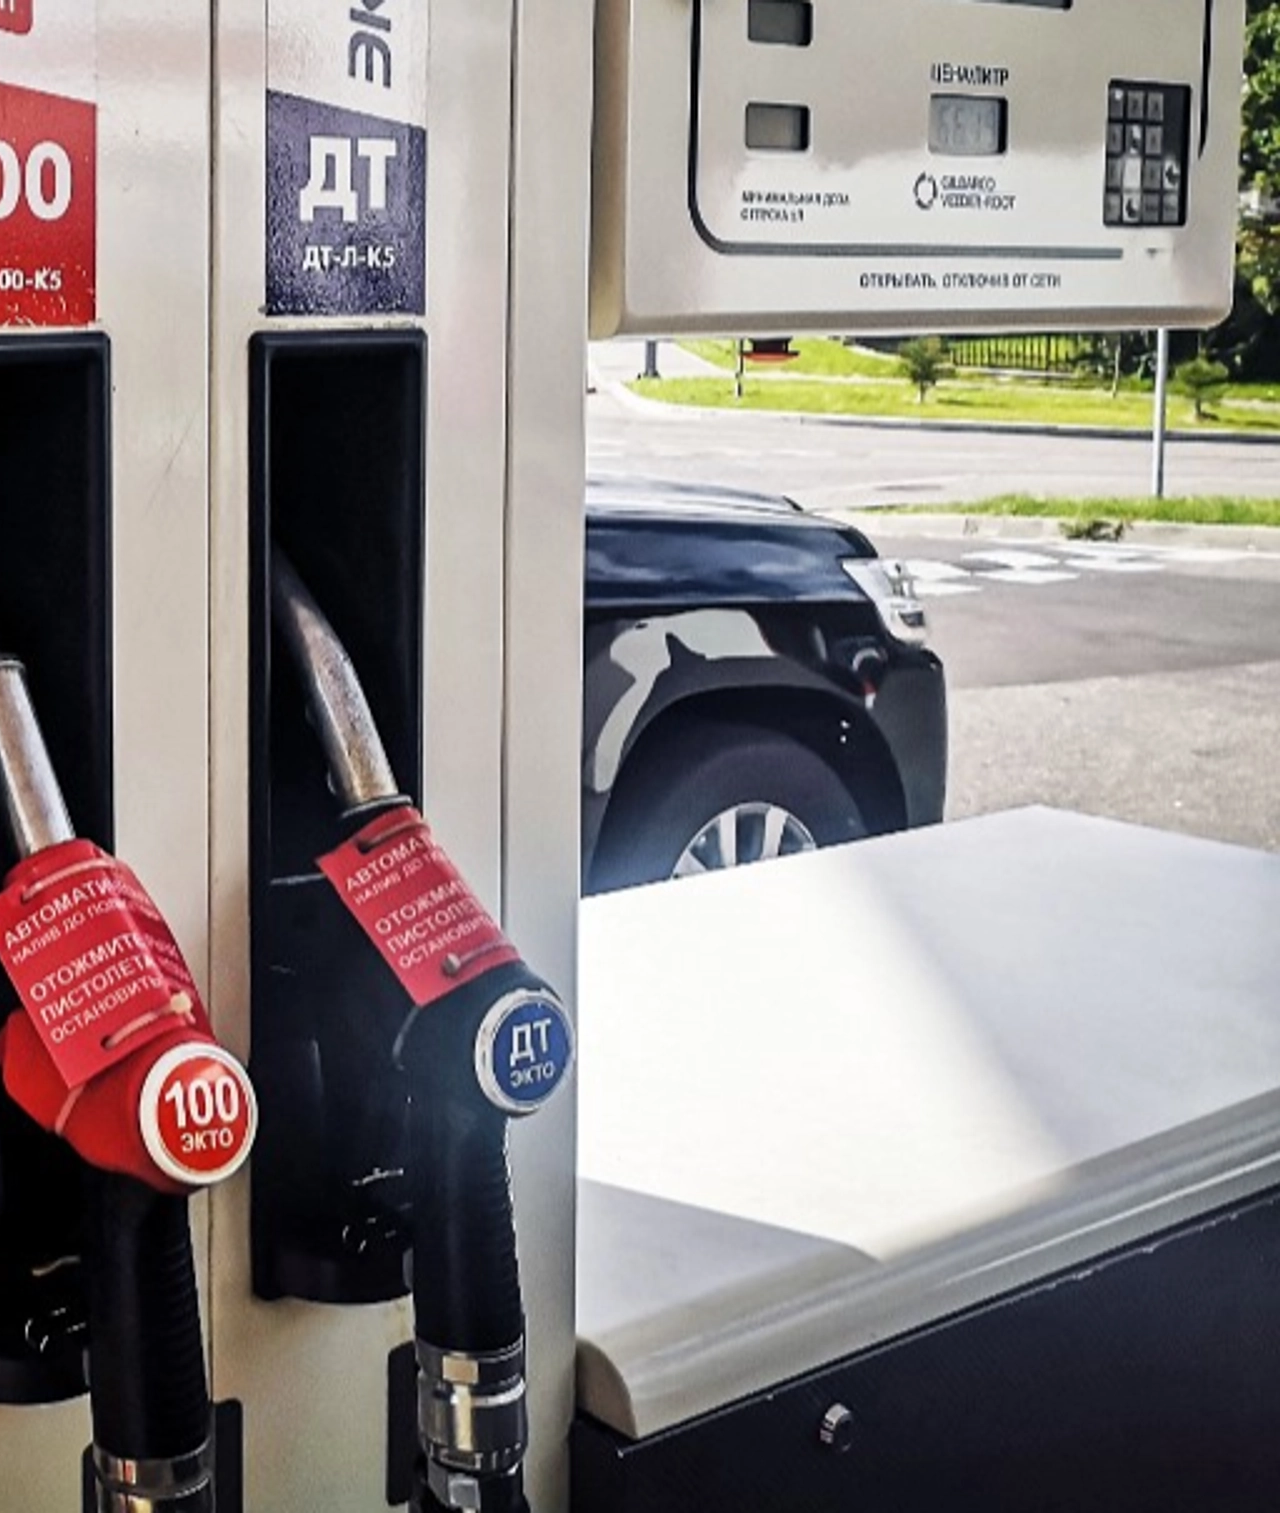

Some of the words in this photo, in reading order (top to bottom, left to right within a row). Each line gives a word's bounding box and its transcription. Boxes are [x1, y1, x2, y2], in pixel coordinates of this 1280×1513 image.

[298, 136, 397, 222] ДТ
[301, 244, 396, 272] ДТ-Л-К5
[509, 1017, 552, 1068] ДТ
[509, 1060, 556, 1089] ЭКТО
[164, 1075, 240, 1129] 100
[181, 1127, 235, 1154] ЭКТО
